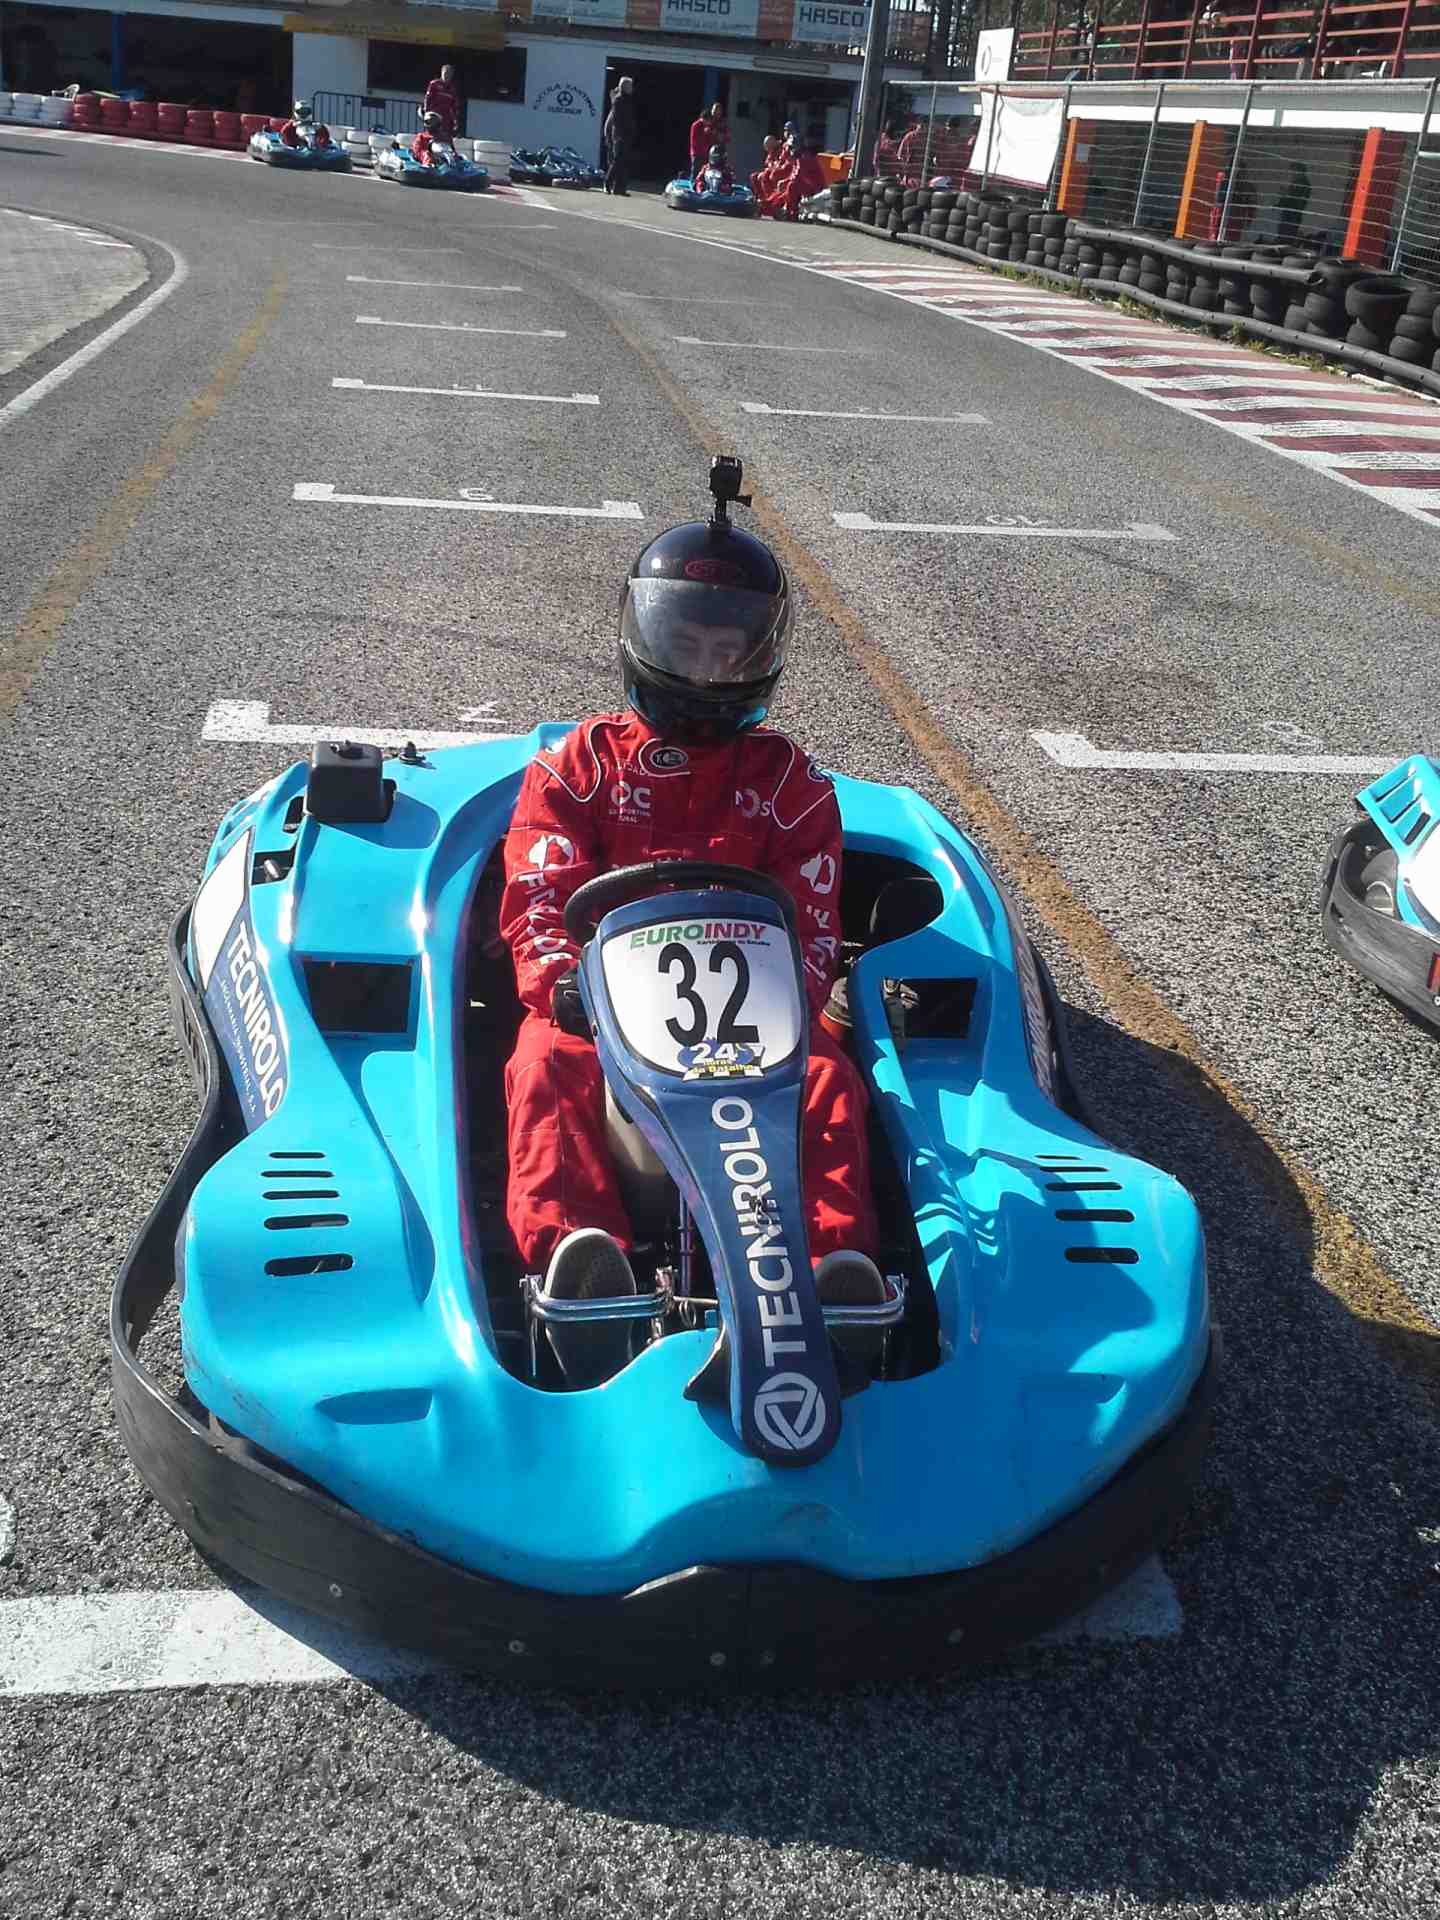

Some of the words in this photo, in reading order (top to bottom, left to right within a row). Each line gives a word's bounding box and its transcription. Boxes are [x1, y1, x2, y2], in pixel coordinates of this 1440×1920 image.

[799, 7, 865, 28] HASCO
[630, 923, 768, 949] EUROINDY
[227, 920, 284, 1120] TECNIROLO
[657, 942, 760, 1047] 32
[711, 1095, 807, 1368] TECNIROLO
